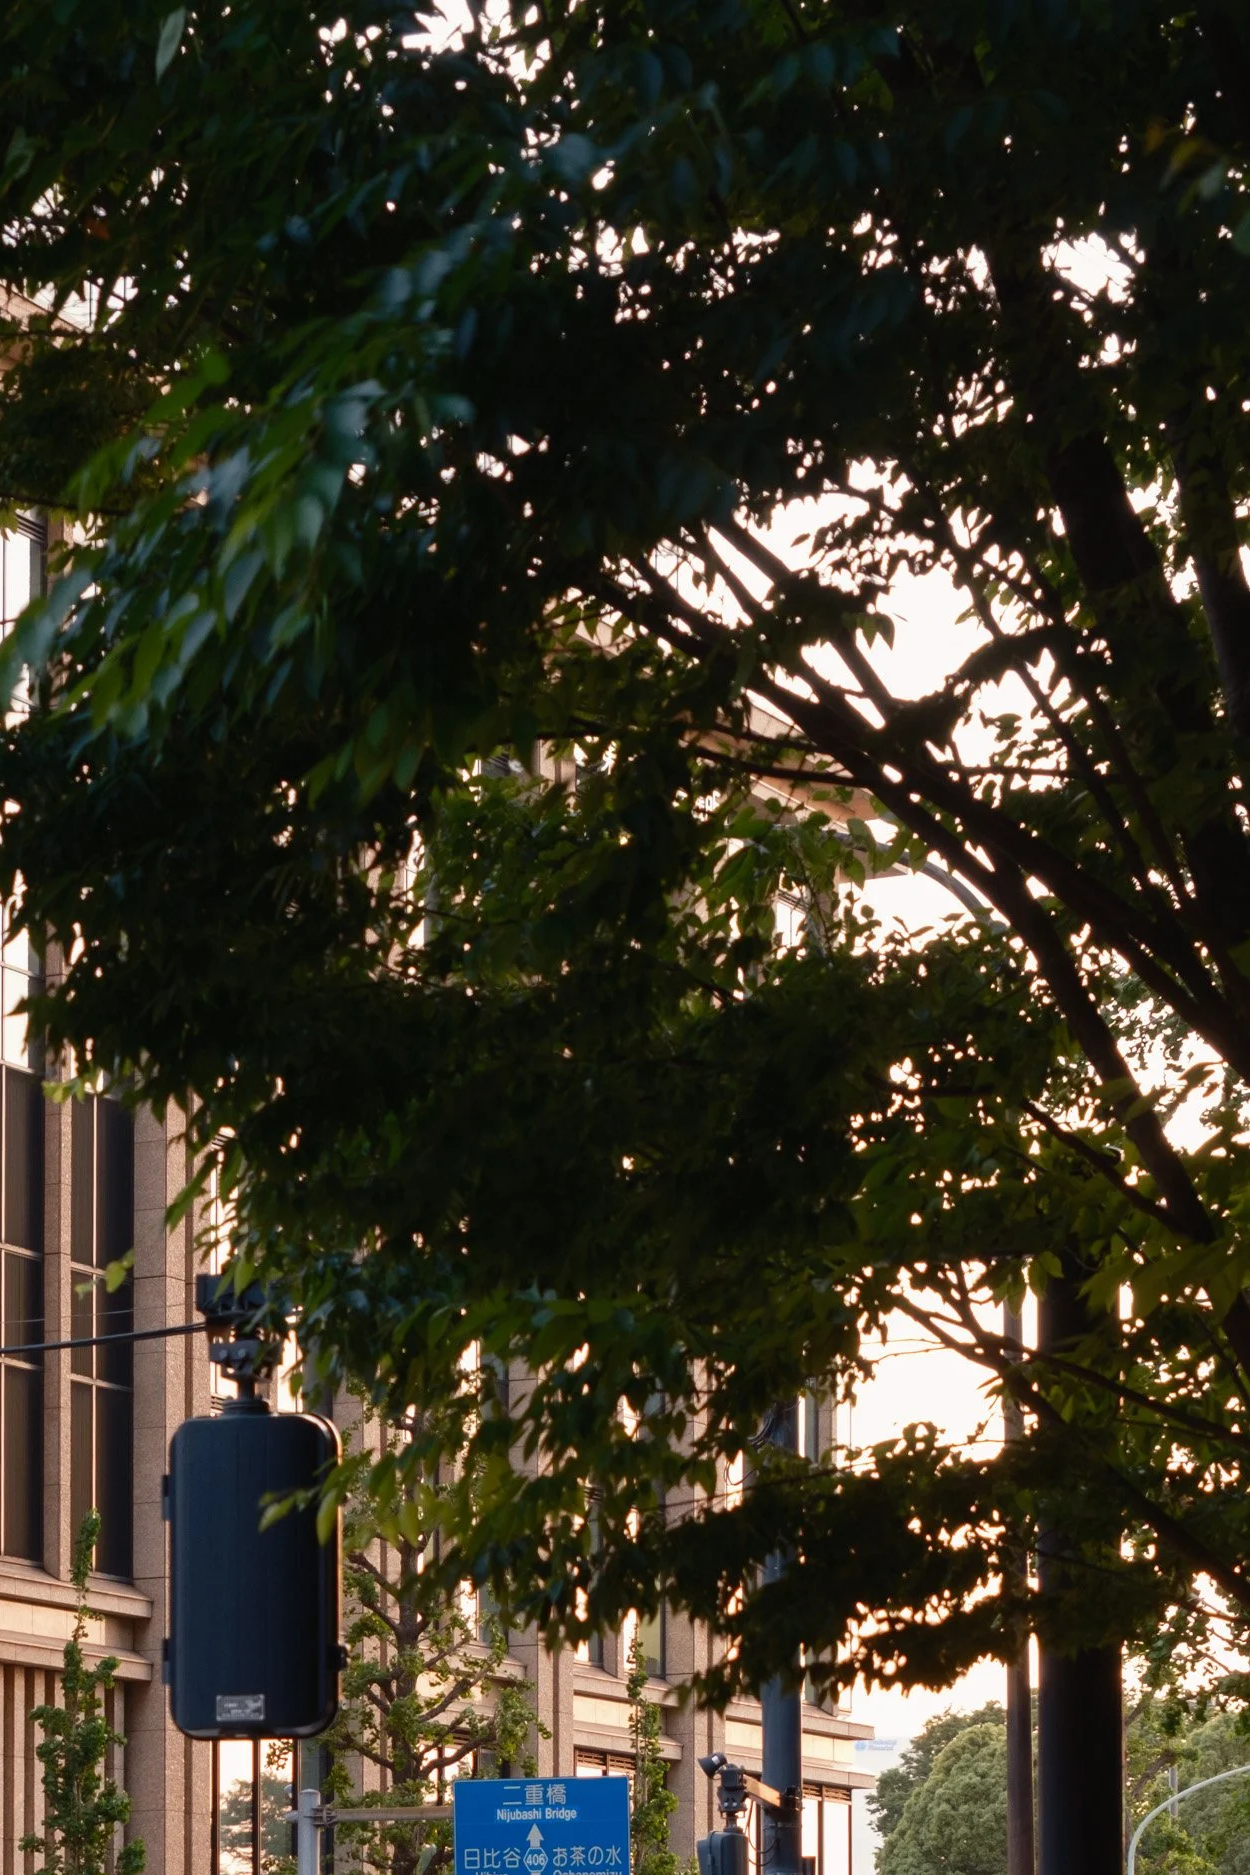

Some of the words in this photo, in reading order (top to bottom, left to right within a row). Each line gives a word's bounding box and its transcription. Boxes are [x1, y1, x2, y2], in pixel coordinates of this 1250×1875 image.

[503, 1783, 567, 1806] 二重橋
[496, 1808, 542, 1823] Nijubashi
[545, 1807, 577, 1821] Bridge
[464, 1848, 521, 1869] 日比谷
[526, 1854, 546, 1866] 406
[552, 1845, 622, 1867] お茶の水
